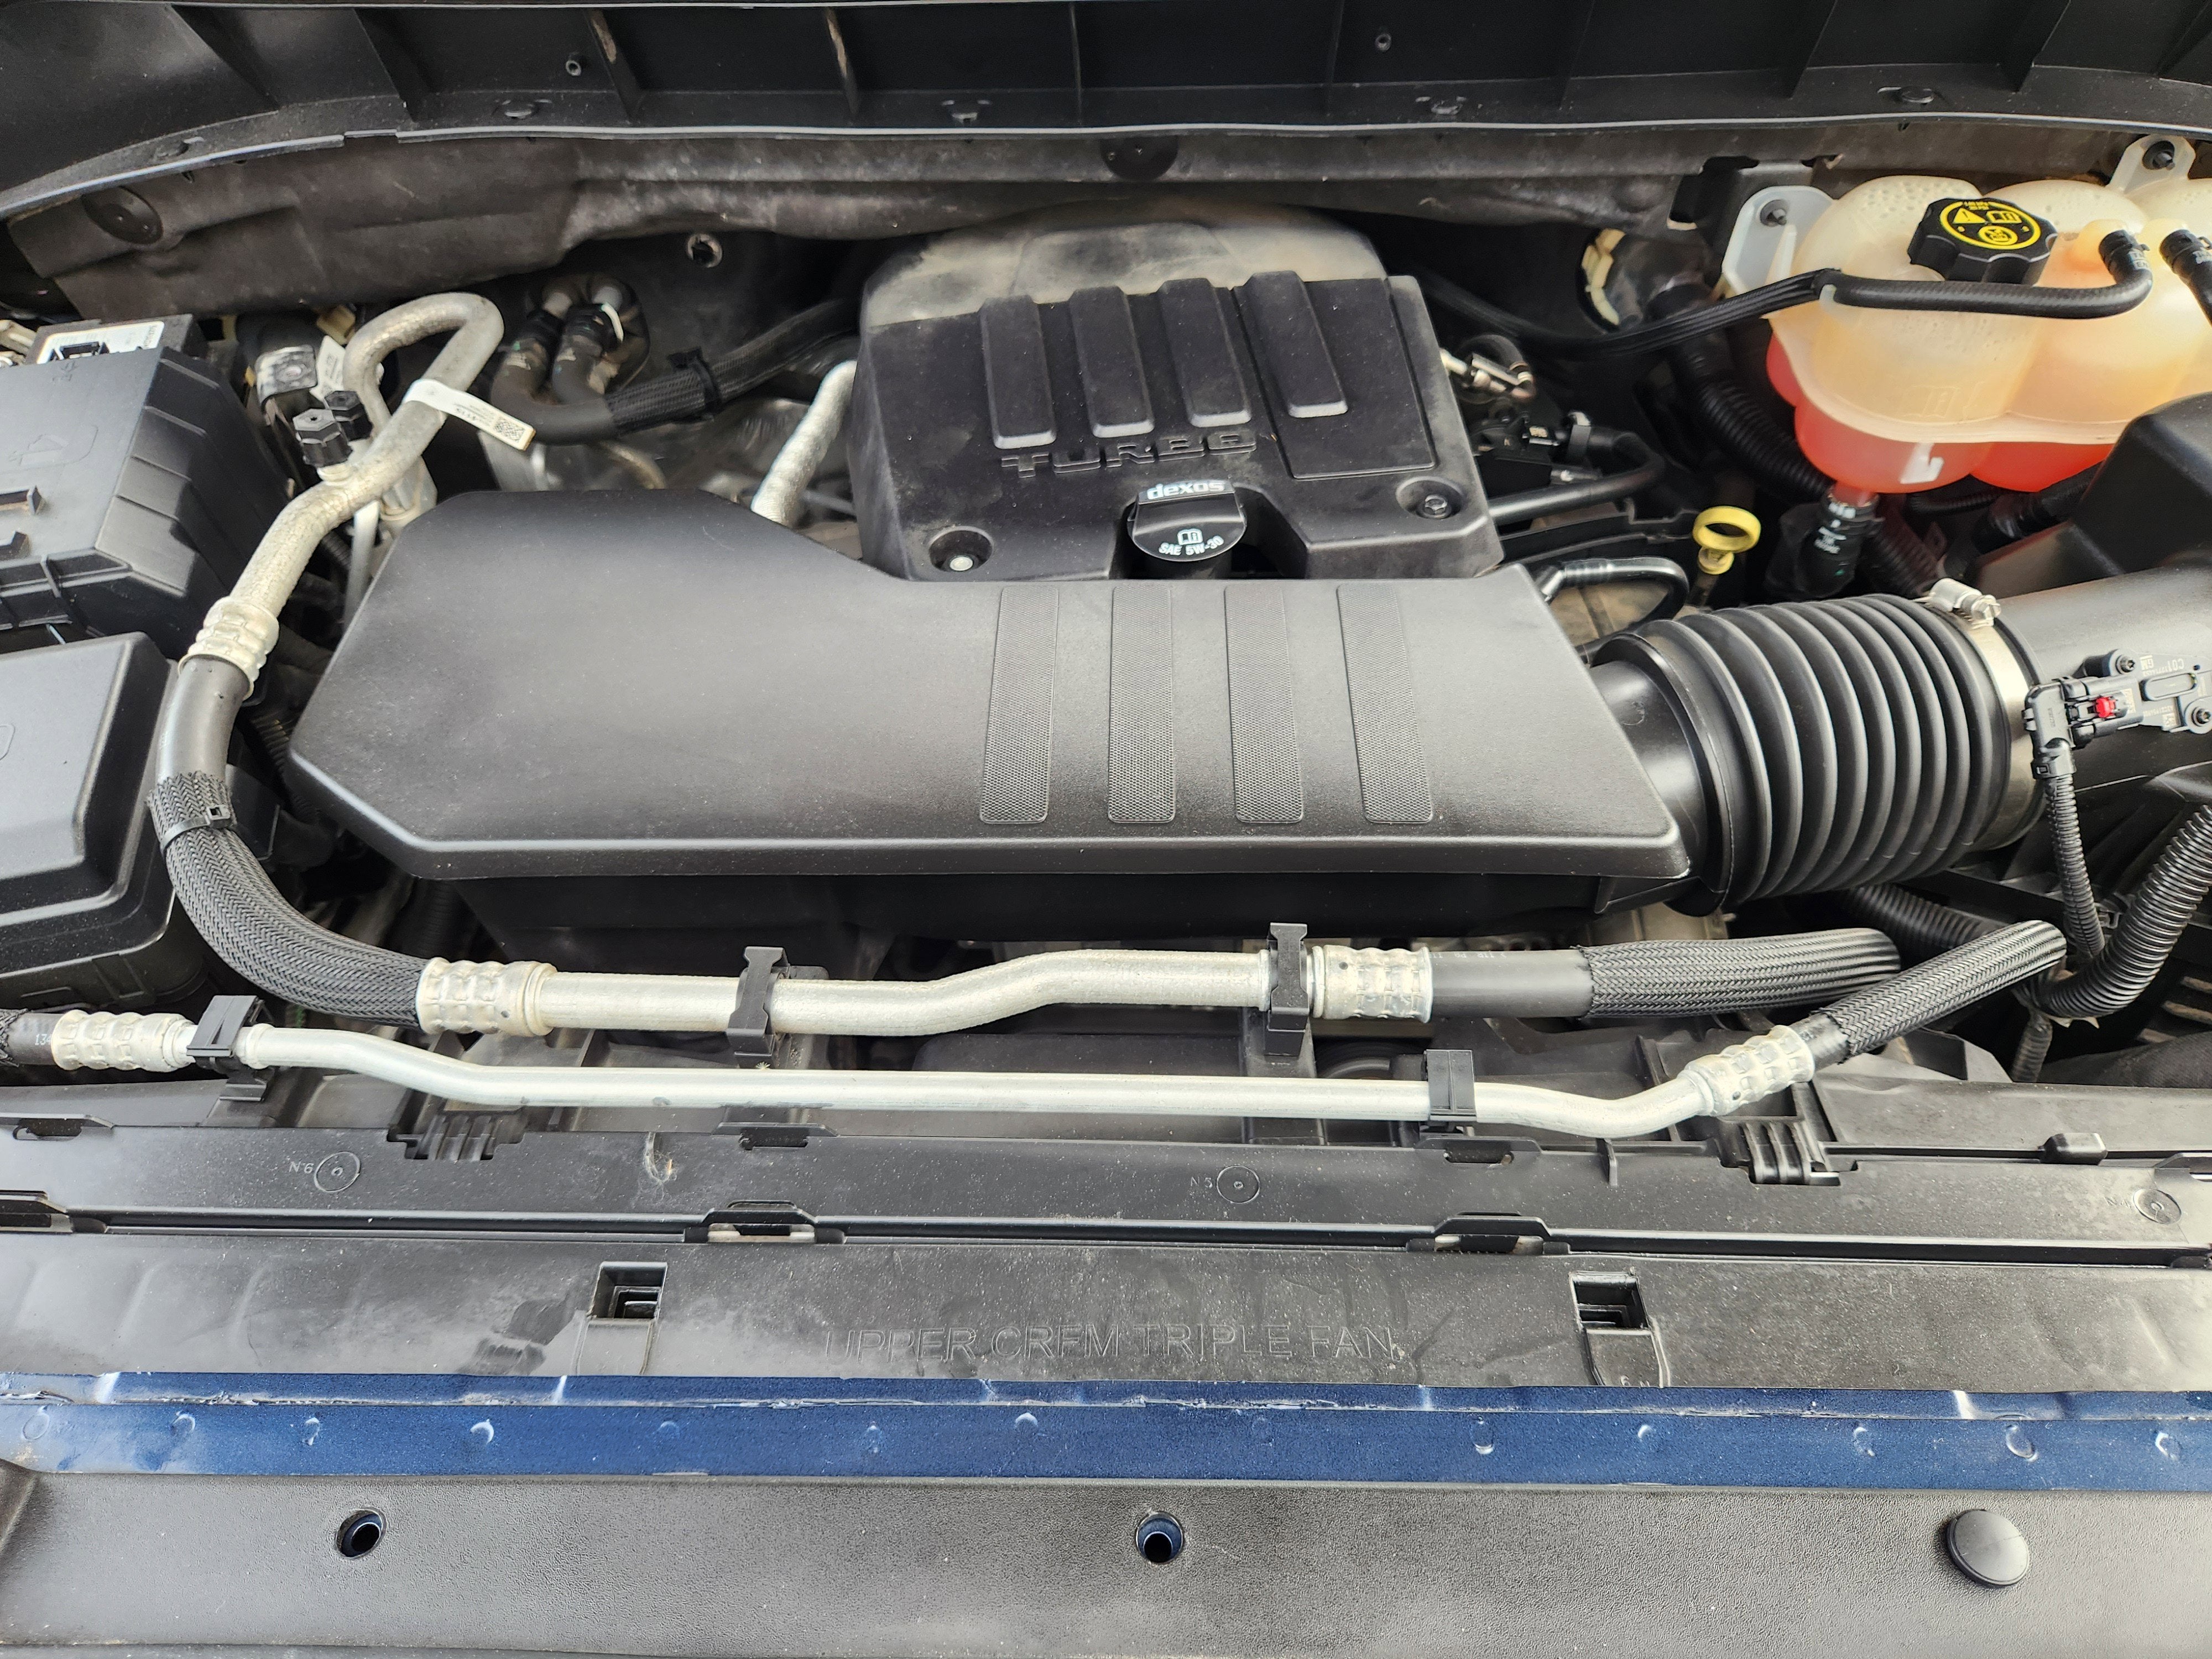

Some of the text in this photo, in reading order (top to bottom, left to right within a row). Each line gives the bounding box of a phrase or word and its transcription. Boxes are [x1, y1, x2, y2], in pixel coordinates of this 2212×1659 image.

[1001, 432, 1257, 478] TURBO
[1146, 481, 1225, 500] dexos
[1159, 535, 1224, 555] SAE 5W-30
[826, 1324, 1395, 1364] UPPER CRFM TRIPLE FAN
